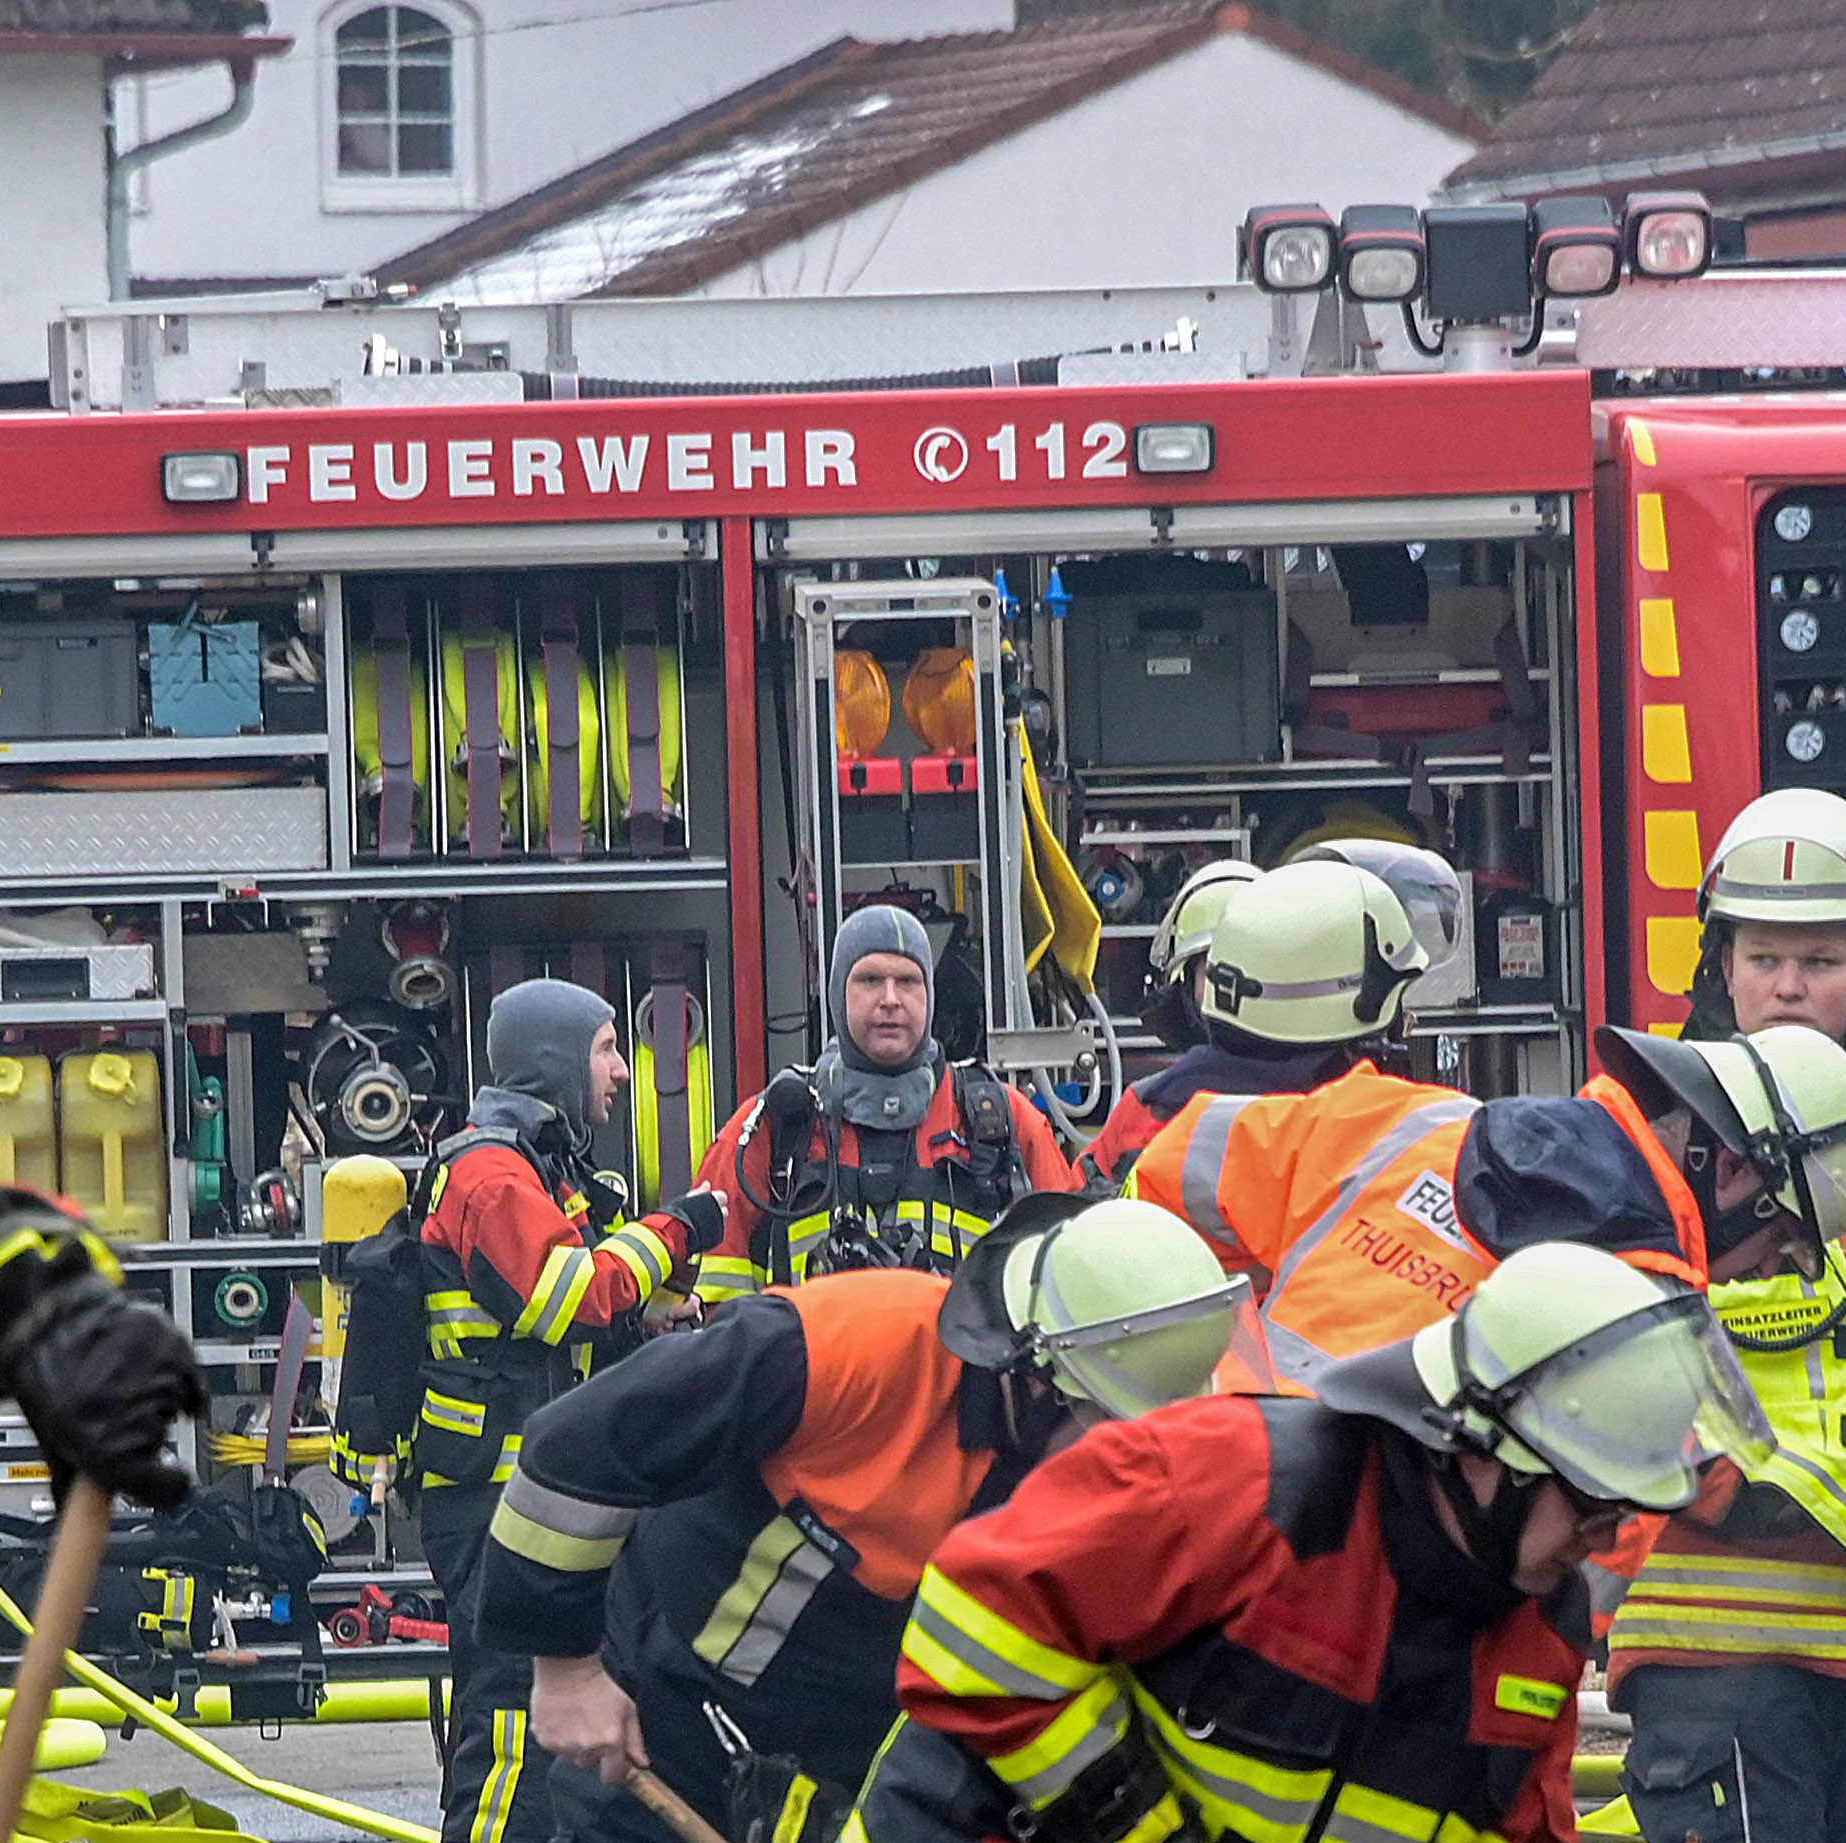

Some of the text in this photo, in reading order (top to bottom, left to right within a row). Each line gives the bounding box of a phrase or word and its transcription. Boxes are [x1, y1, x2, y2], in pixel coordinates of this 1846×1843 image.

[247, 422, 1130, 503] FEUERWEHR 112
[1722, 1306, 1822, 1327] EINSATZLEITER
